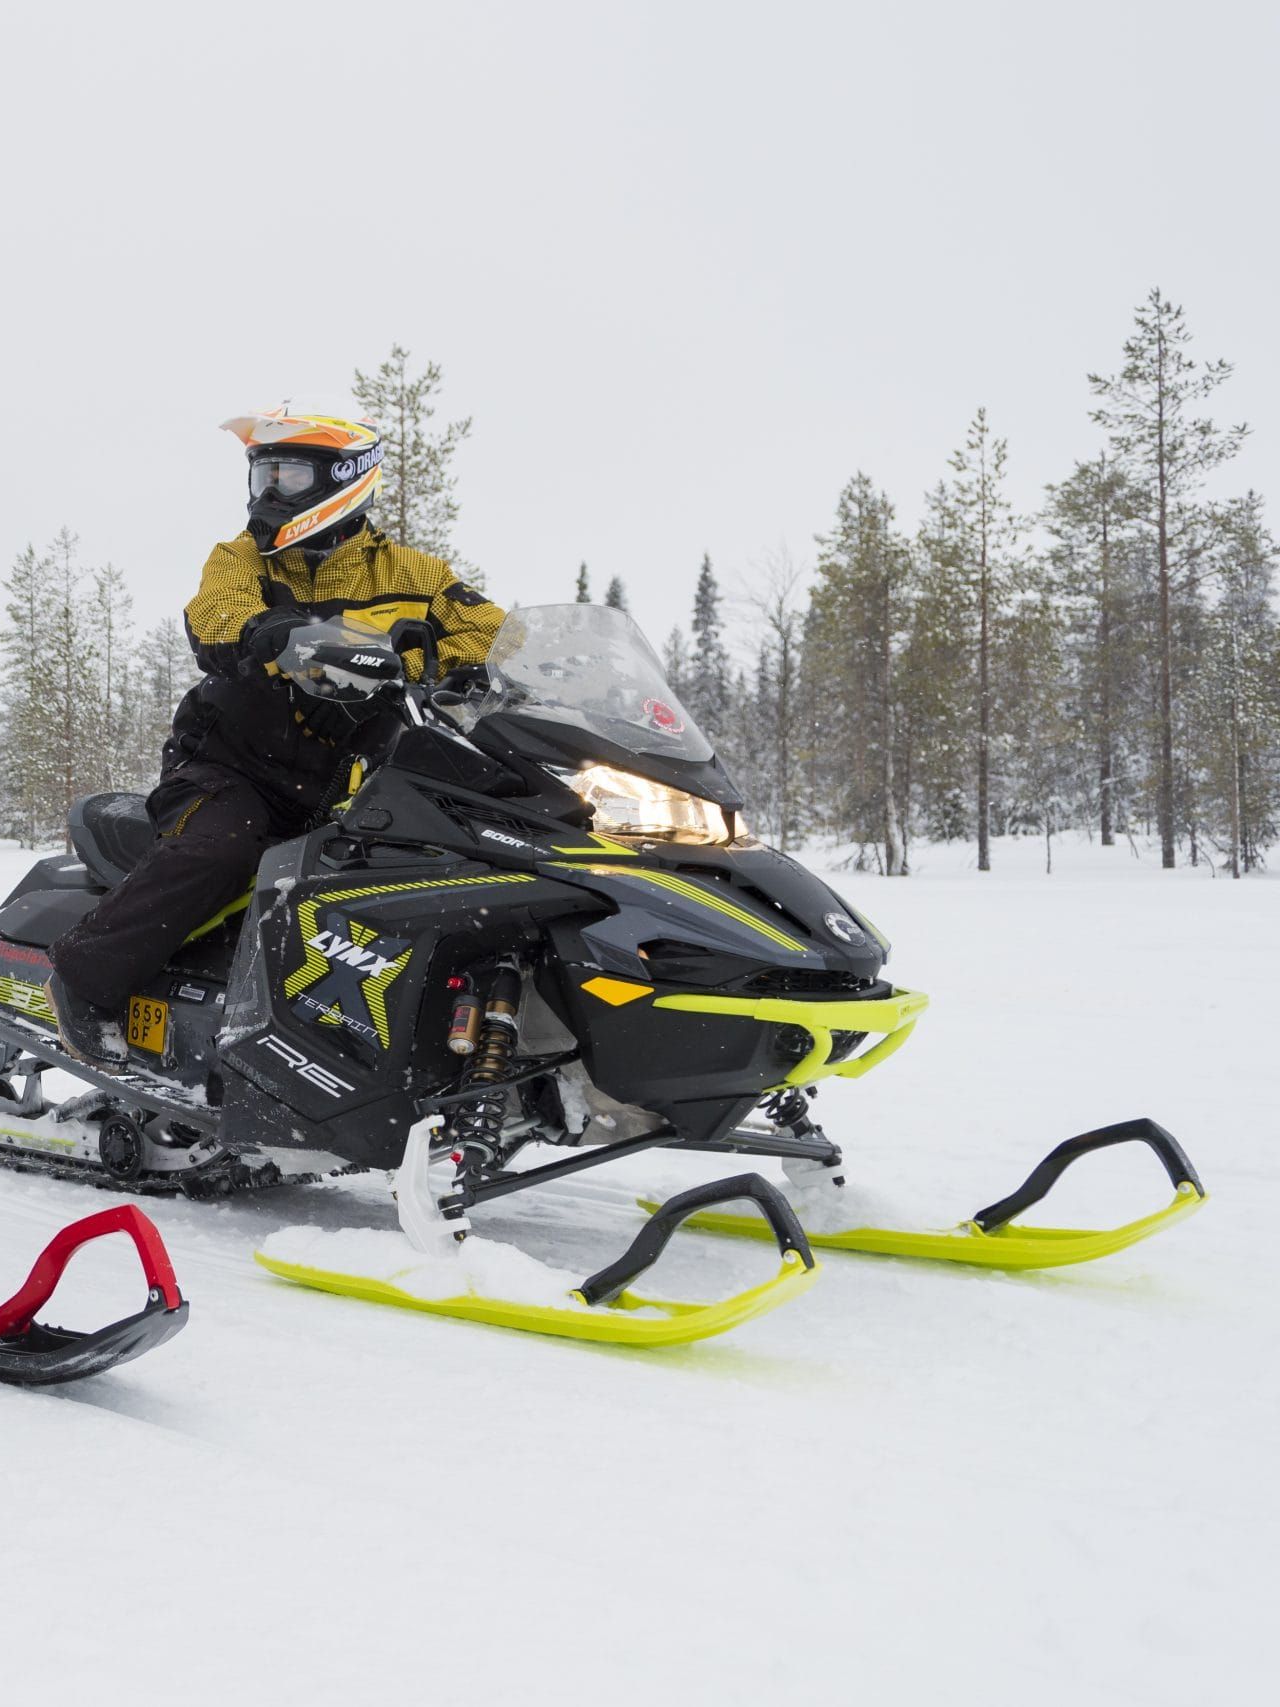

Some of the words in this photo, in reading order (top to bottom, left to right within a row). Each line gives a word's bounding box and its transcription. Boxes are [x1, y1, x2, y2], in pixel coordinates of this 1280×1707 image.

[284, 512, 320, 541] LYNX
[350, 653, 386, 668] LYNX
[306, 930, 401, 978] LYNX
[132, 1002, 163, 1025] 659
[256, 1034, 356, 1098] RE
